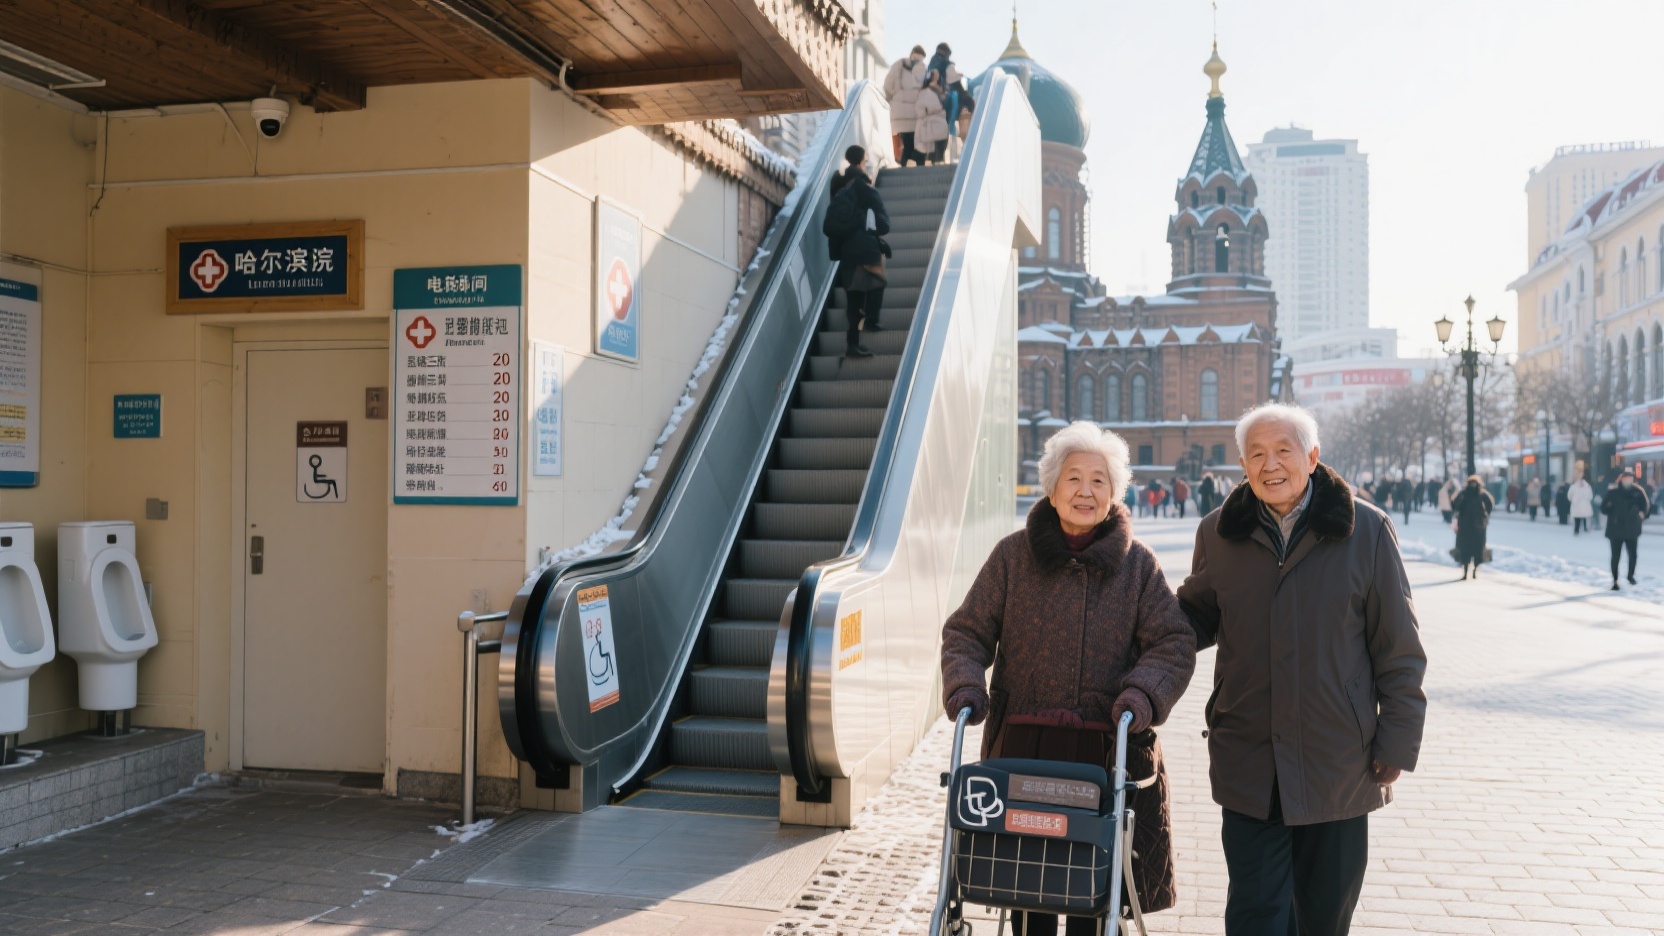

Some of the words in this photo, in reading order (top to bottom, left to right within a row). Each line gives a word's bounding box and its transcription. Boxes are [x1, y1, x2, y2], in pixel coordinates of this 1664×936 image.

[492, 352, 510, 367] 20
[493, 371, 511, 386] 20
[493, 390, 510, 404] 20
